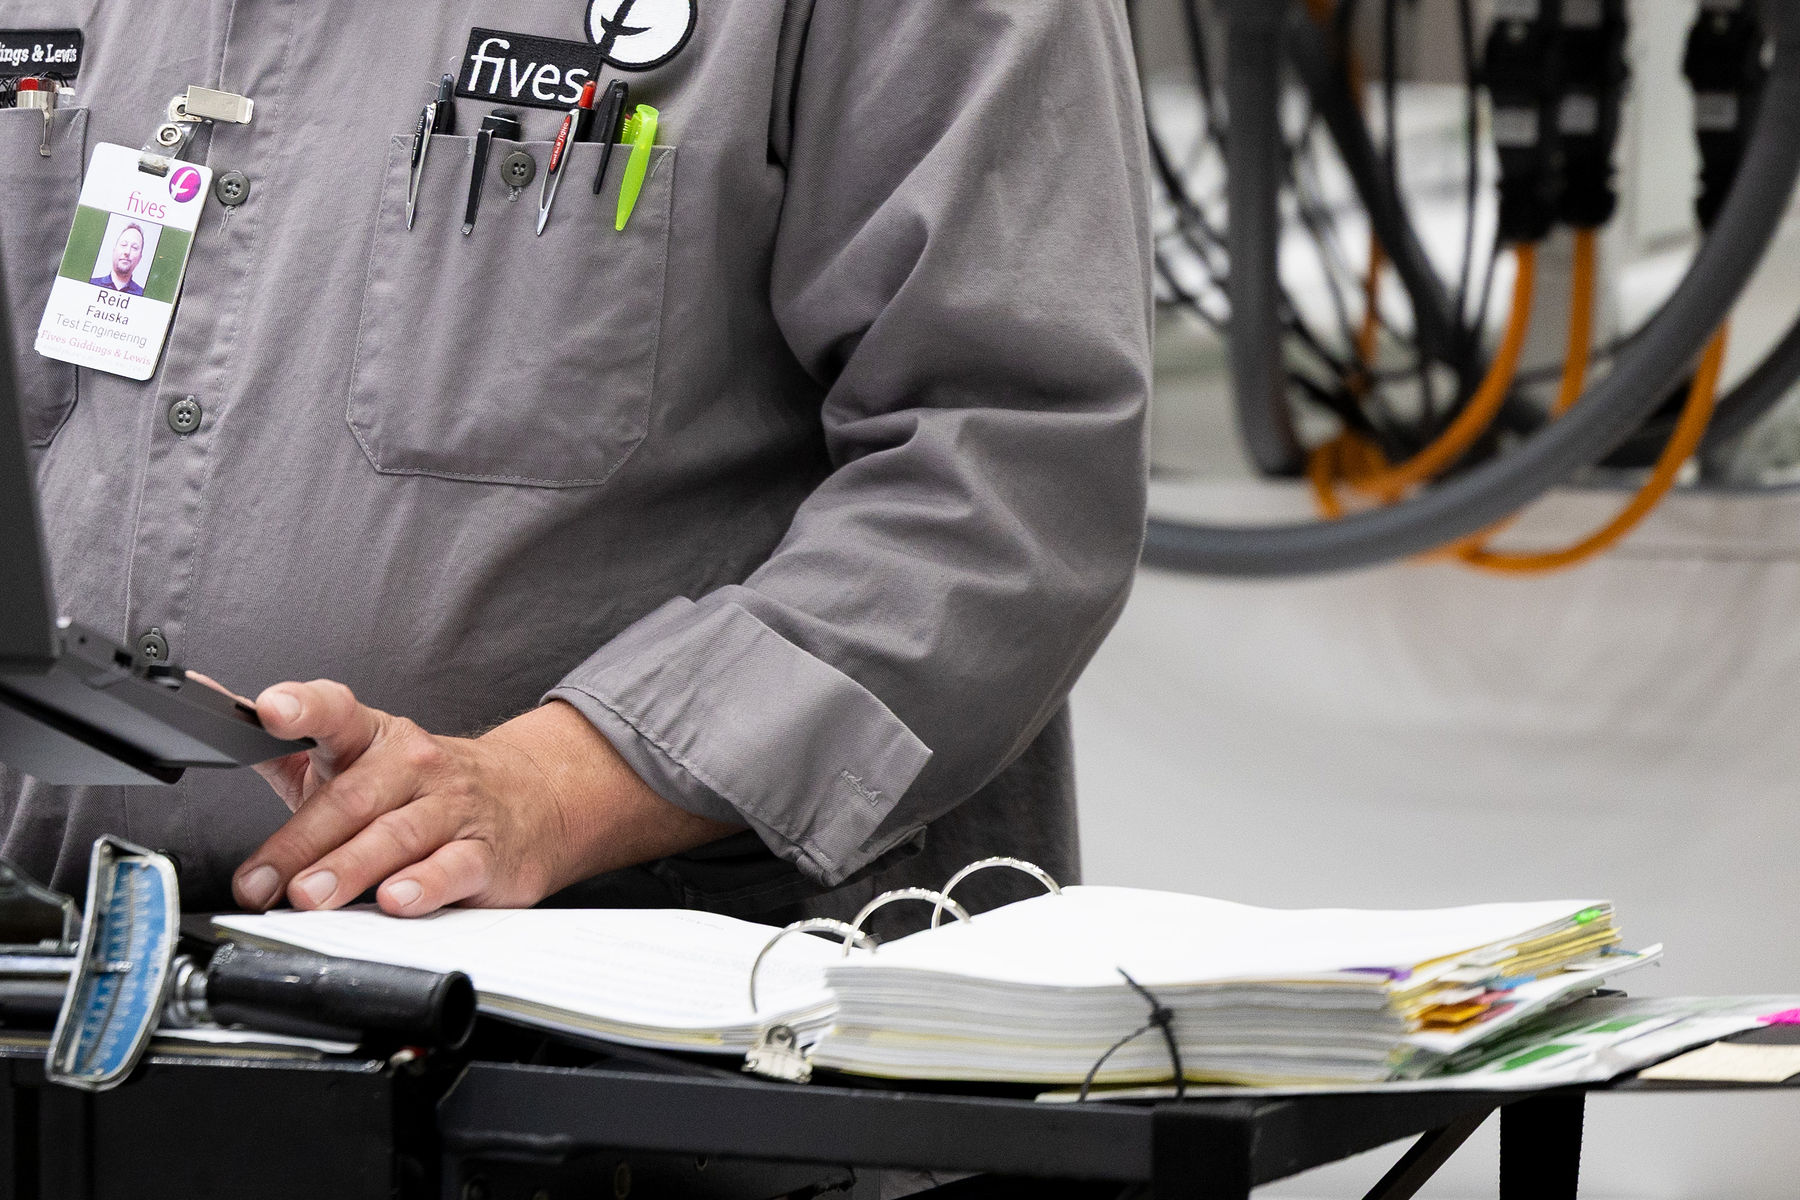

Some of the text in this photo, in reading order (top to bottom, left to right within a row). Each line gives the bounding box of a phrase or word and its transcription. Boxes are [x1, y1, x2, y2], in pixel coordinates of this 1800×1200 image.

[32, 44, 44, 63] &
[45, 43, 77, 63] Lewis
[467, 37, 591, 105] fives
[127, 191, 167, 220] fives
[96, 290, 131, 310] Reid
[86, 305, 129, 326] Fauska
[55, 313, 148, 349] Test Engineering
[40, 329, 67, 345] Fives
[68, 336, 112, 357] Giddings
[113, 348, 122, 358] &
[123, 349, 151, 366] Lewis
